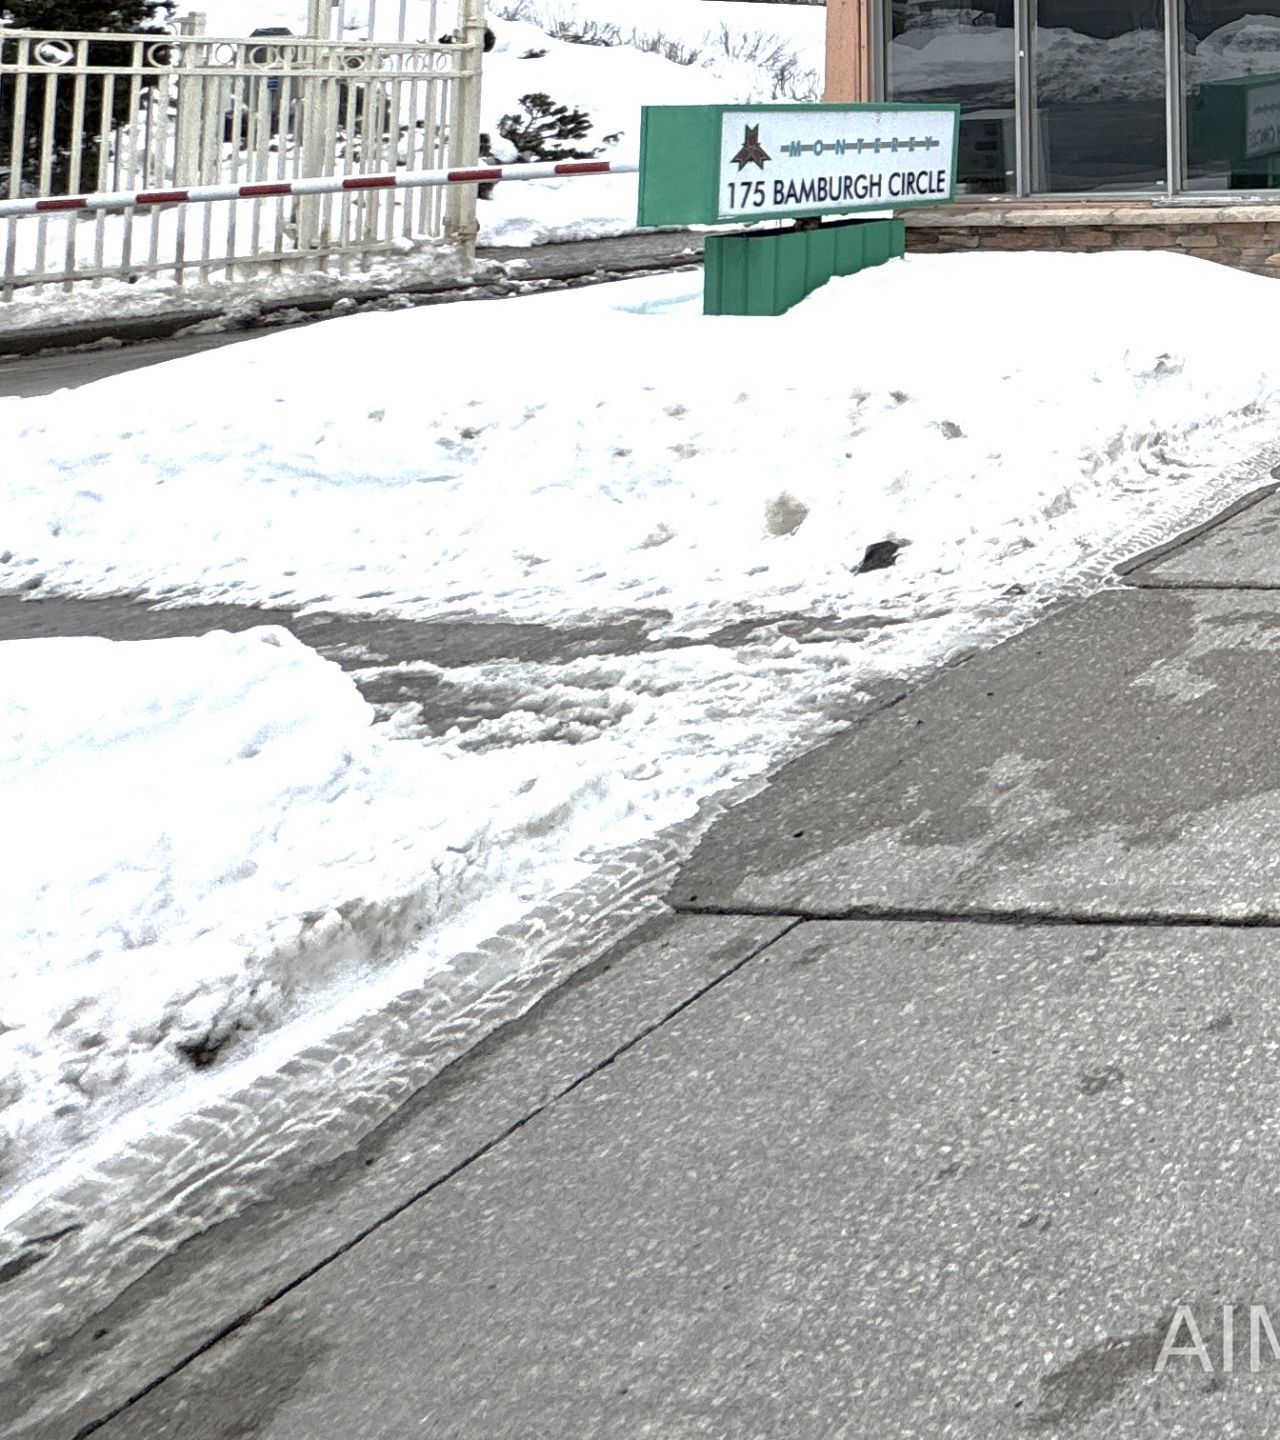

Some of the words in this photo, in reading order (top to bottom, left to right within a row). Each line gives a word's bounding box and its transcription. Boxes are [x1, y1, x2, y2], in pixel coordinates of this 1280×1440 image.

[789, 136, 933, 157] MONTEREY
[727, 180, 766, 209] 175
[773, 173, 882, 206] BAMBURGH
[888, 169, 946, 197] CIRCLE
